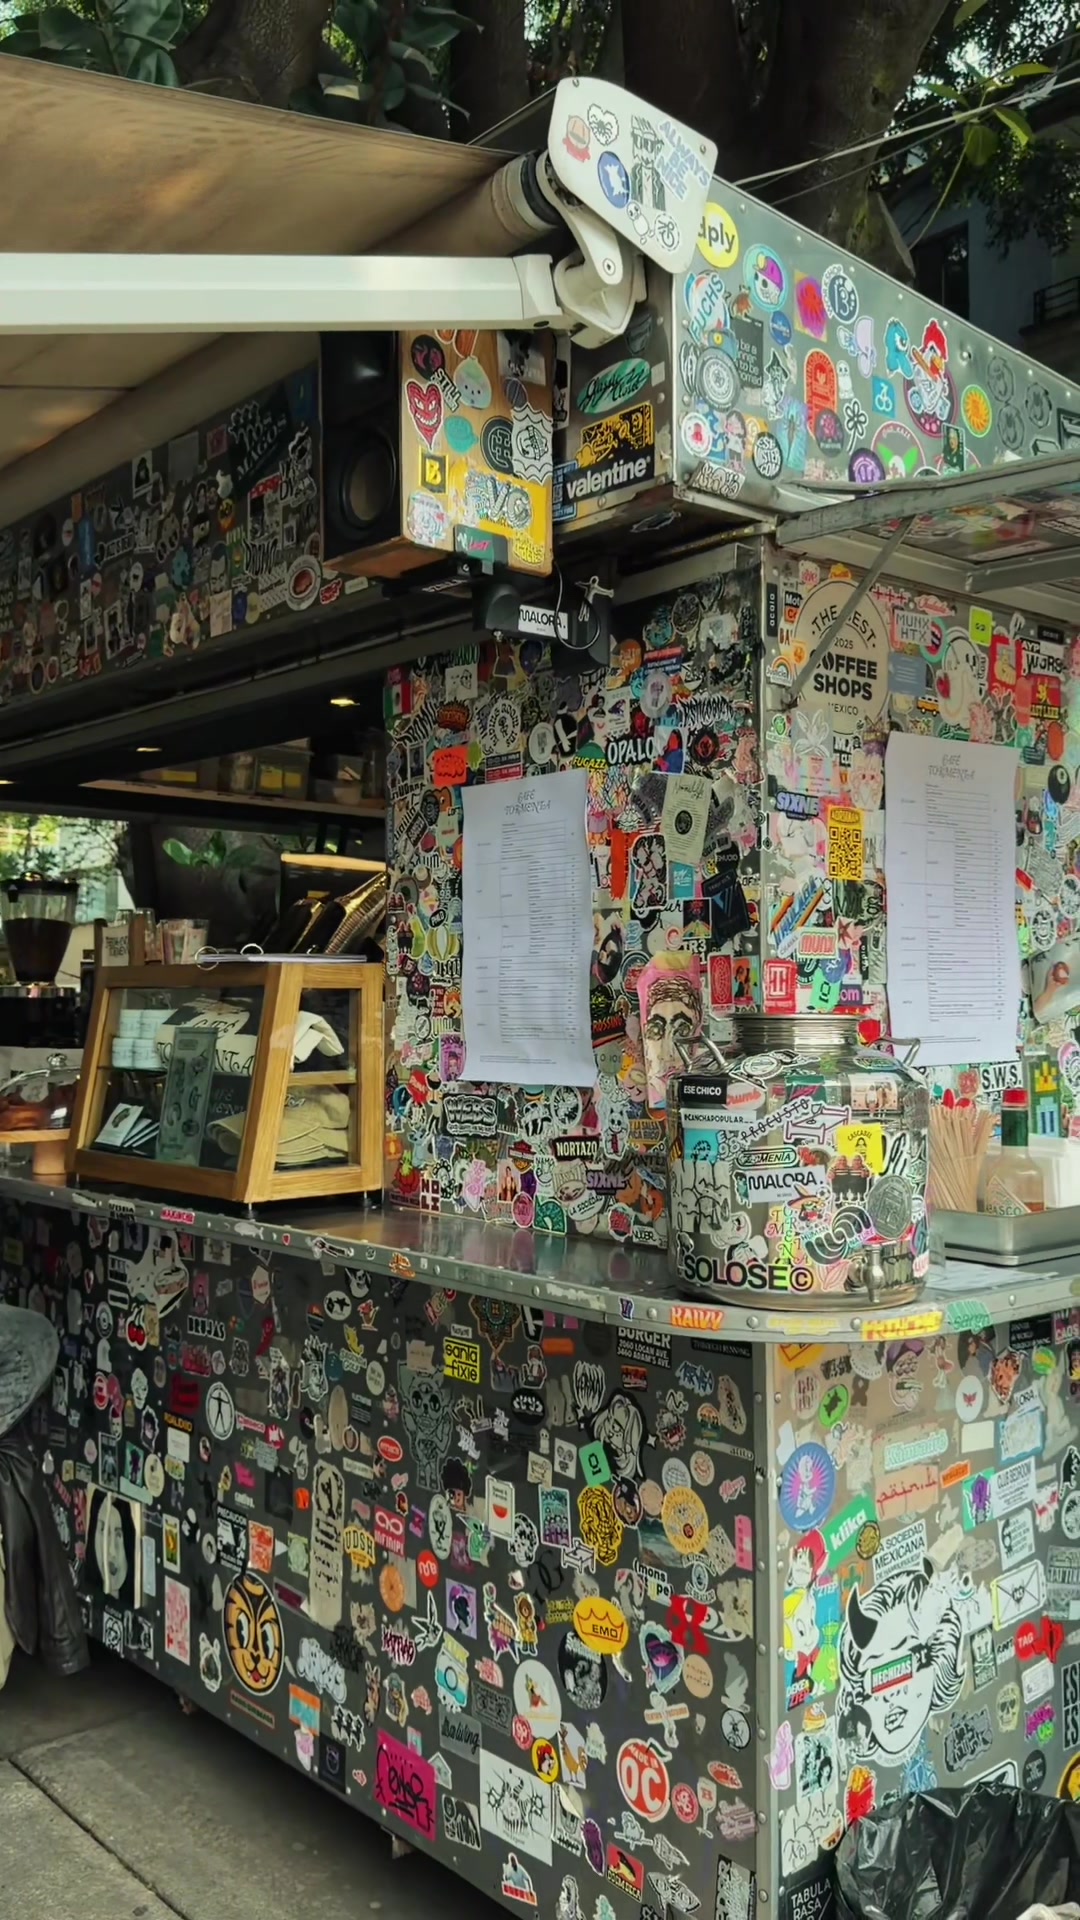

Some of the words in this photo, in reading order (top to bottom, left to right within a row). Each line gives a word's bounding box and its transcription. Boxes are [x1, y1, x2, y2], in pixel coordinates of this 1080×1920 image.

[659, 121, 710, 187] ALWAYS
[671, 154, 688, 177] BE
[656, 157, 688, 200] NICE
[690, 274, 723, 338] FUCHS
[812, 605, 838, 632] THE
[849, 610, 877, 642] EST
[896, 612, 930, 629] MUNX
[834, 637, 854, 650] 2025
[900, 627, 927, 642] HTX
[810, 650, 877, 680] OFFEE
[813, 674, 873, 701] SHOPS
[828, 702, 859, 716] EXICO
[684, 1085, 695, 1094] ESE
[696, 1086, 722, 1096] CHICO
[848, 1130, 873, 1142] CASCABEL
[556, 1141, 598, 1157] NORTAZO
[747, 1171, 824, 1191] MALORA.
[801, 1225, 829, 1242] HUMAN
[445, 1343, 478, 1362] santa
[619, 1339, 634, 1349] 2060
[635, 1341, 655, 1354] LOGAN
[656, 1348, 670, 1360] AVE.
[445, 1361, 478, 1381] fixie
[656, 1358, 670, 1369] AVE.
[875, 1537, 925, 1571] MEXICANA
[592, 1624, 618, 1639] EMO
[1018, 1633, 1034, 1647] TAG
[620, 1756, 663, 1813] OC
[791, 1878, 832, 1907] TABULA
[793, 1898, 822, 1920] RASA
